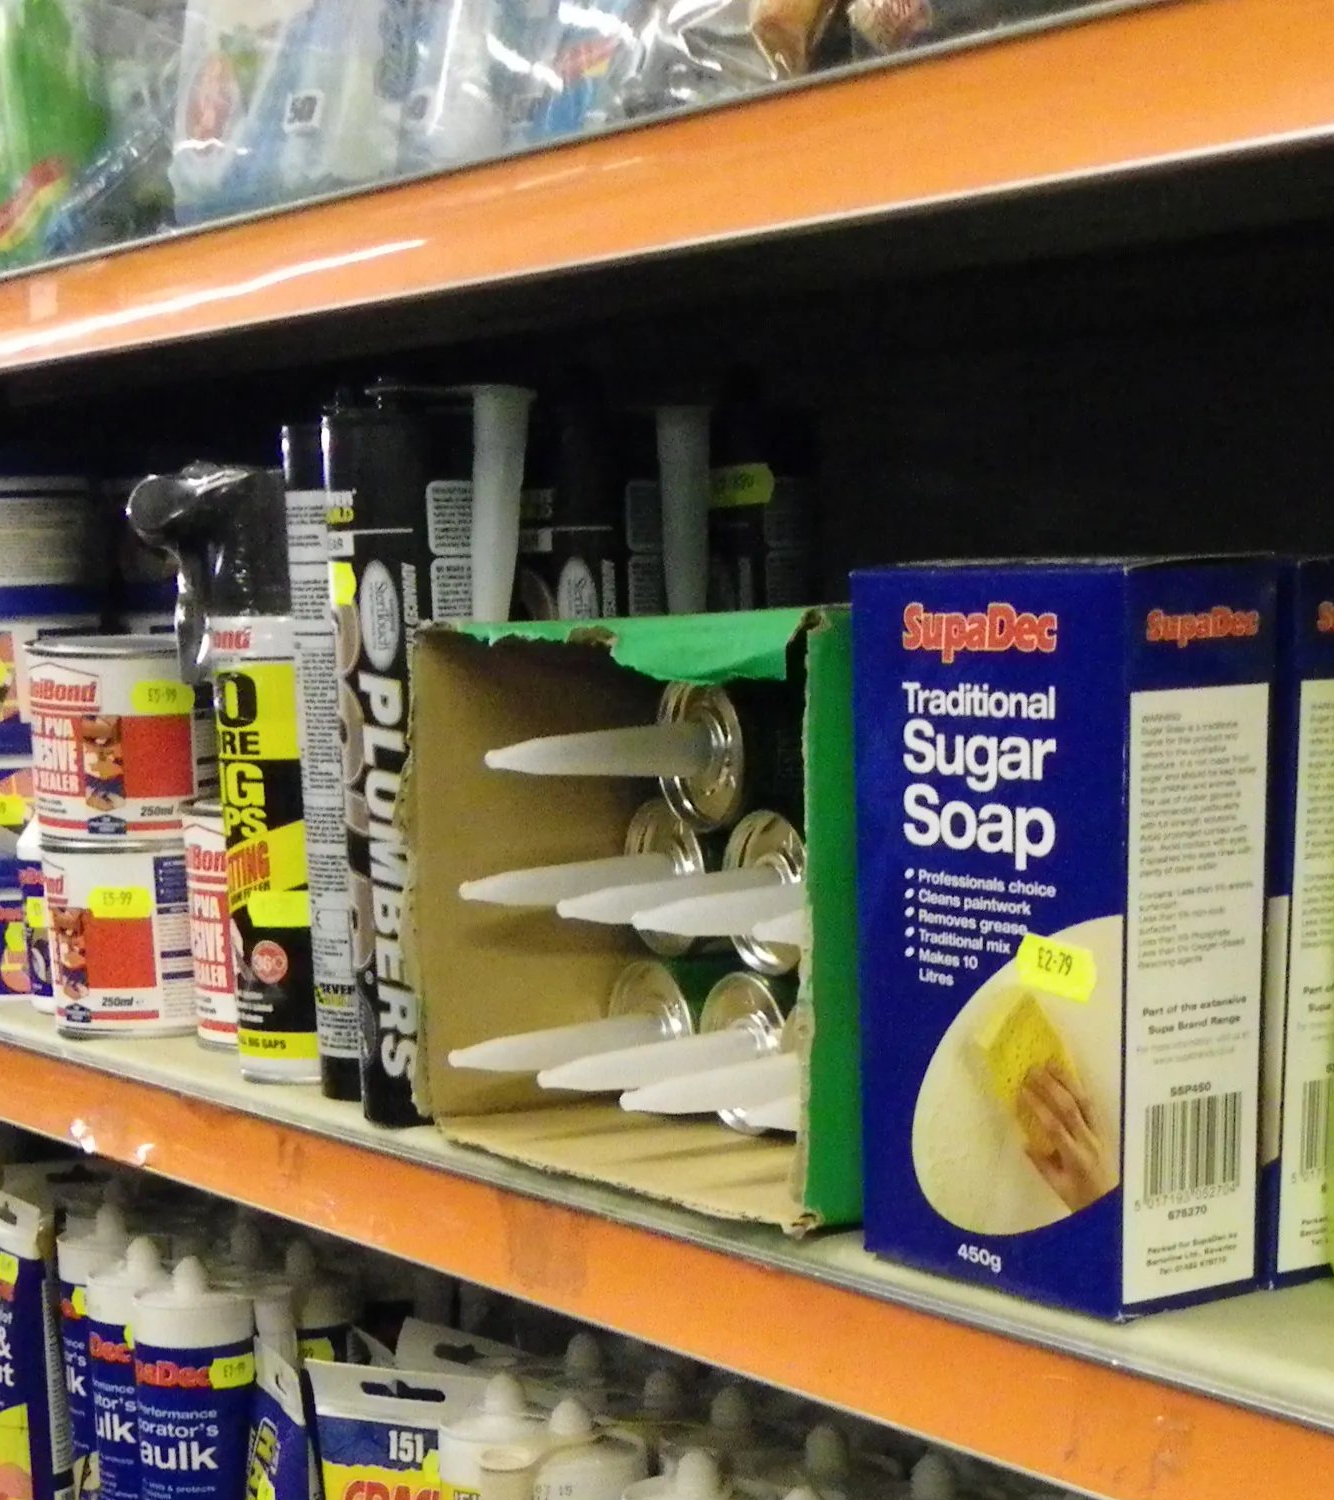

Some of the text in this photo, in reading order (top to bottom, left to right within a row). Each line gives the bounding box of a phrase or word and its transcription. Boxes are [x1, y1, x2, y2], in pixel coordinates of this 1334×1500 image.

[903, 602, 1057, 664] SupaDec
[1146, 606, 1259, 648] SupaDec
[902, 682, 1056, 720] Traditional
[903, 719, 1056, 792] Sugar
[903, 784, 1056, 870] Soap
[918, 869, 1057, 898] Professionals choice
[918, 889, 1031, 916] Cleans paintwork
[918, 908, 1029, 936] Removes grease
[919, 928, 1011, 954] Traditional mix
[919, 948, 978, 970] Makes 10
[919, 968, 954, 987] Litres
[957, 1242, 1002, 1274] 450g
[387, 1429, 424, 1464] 151
